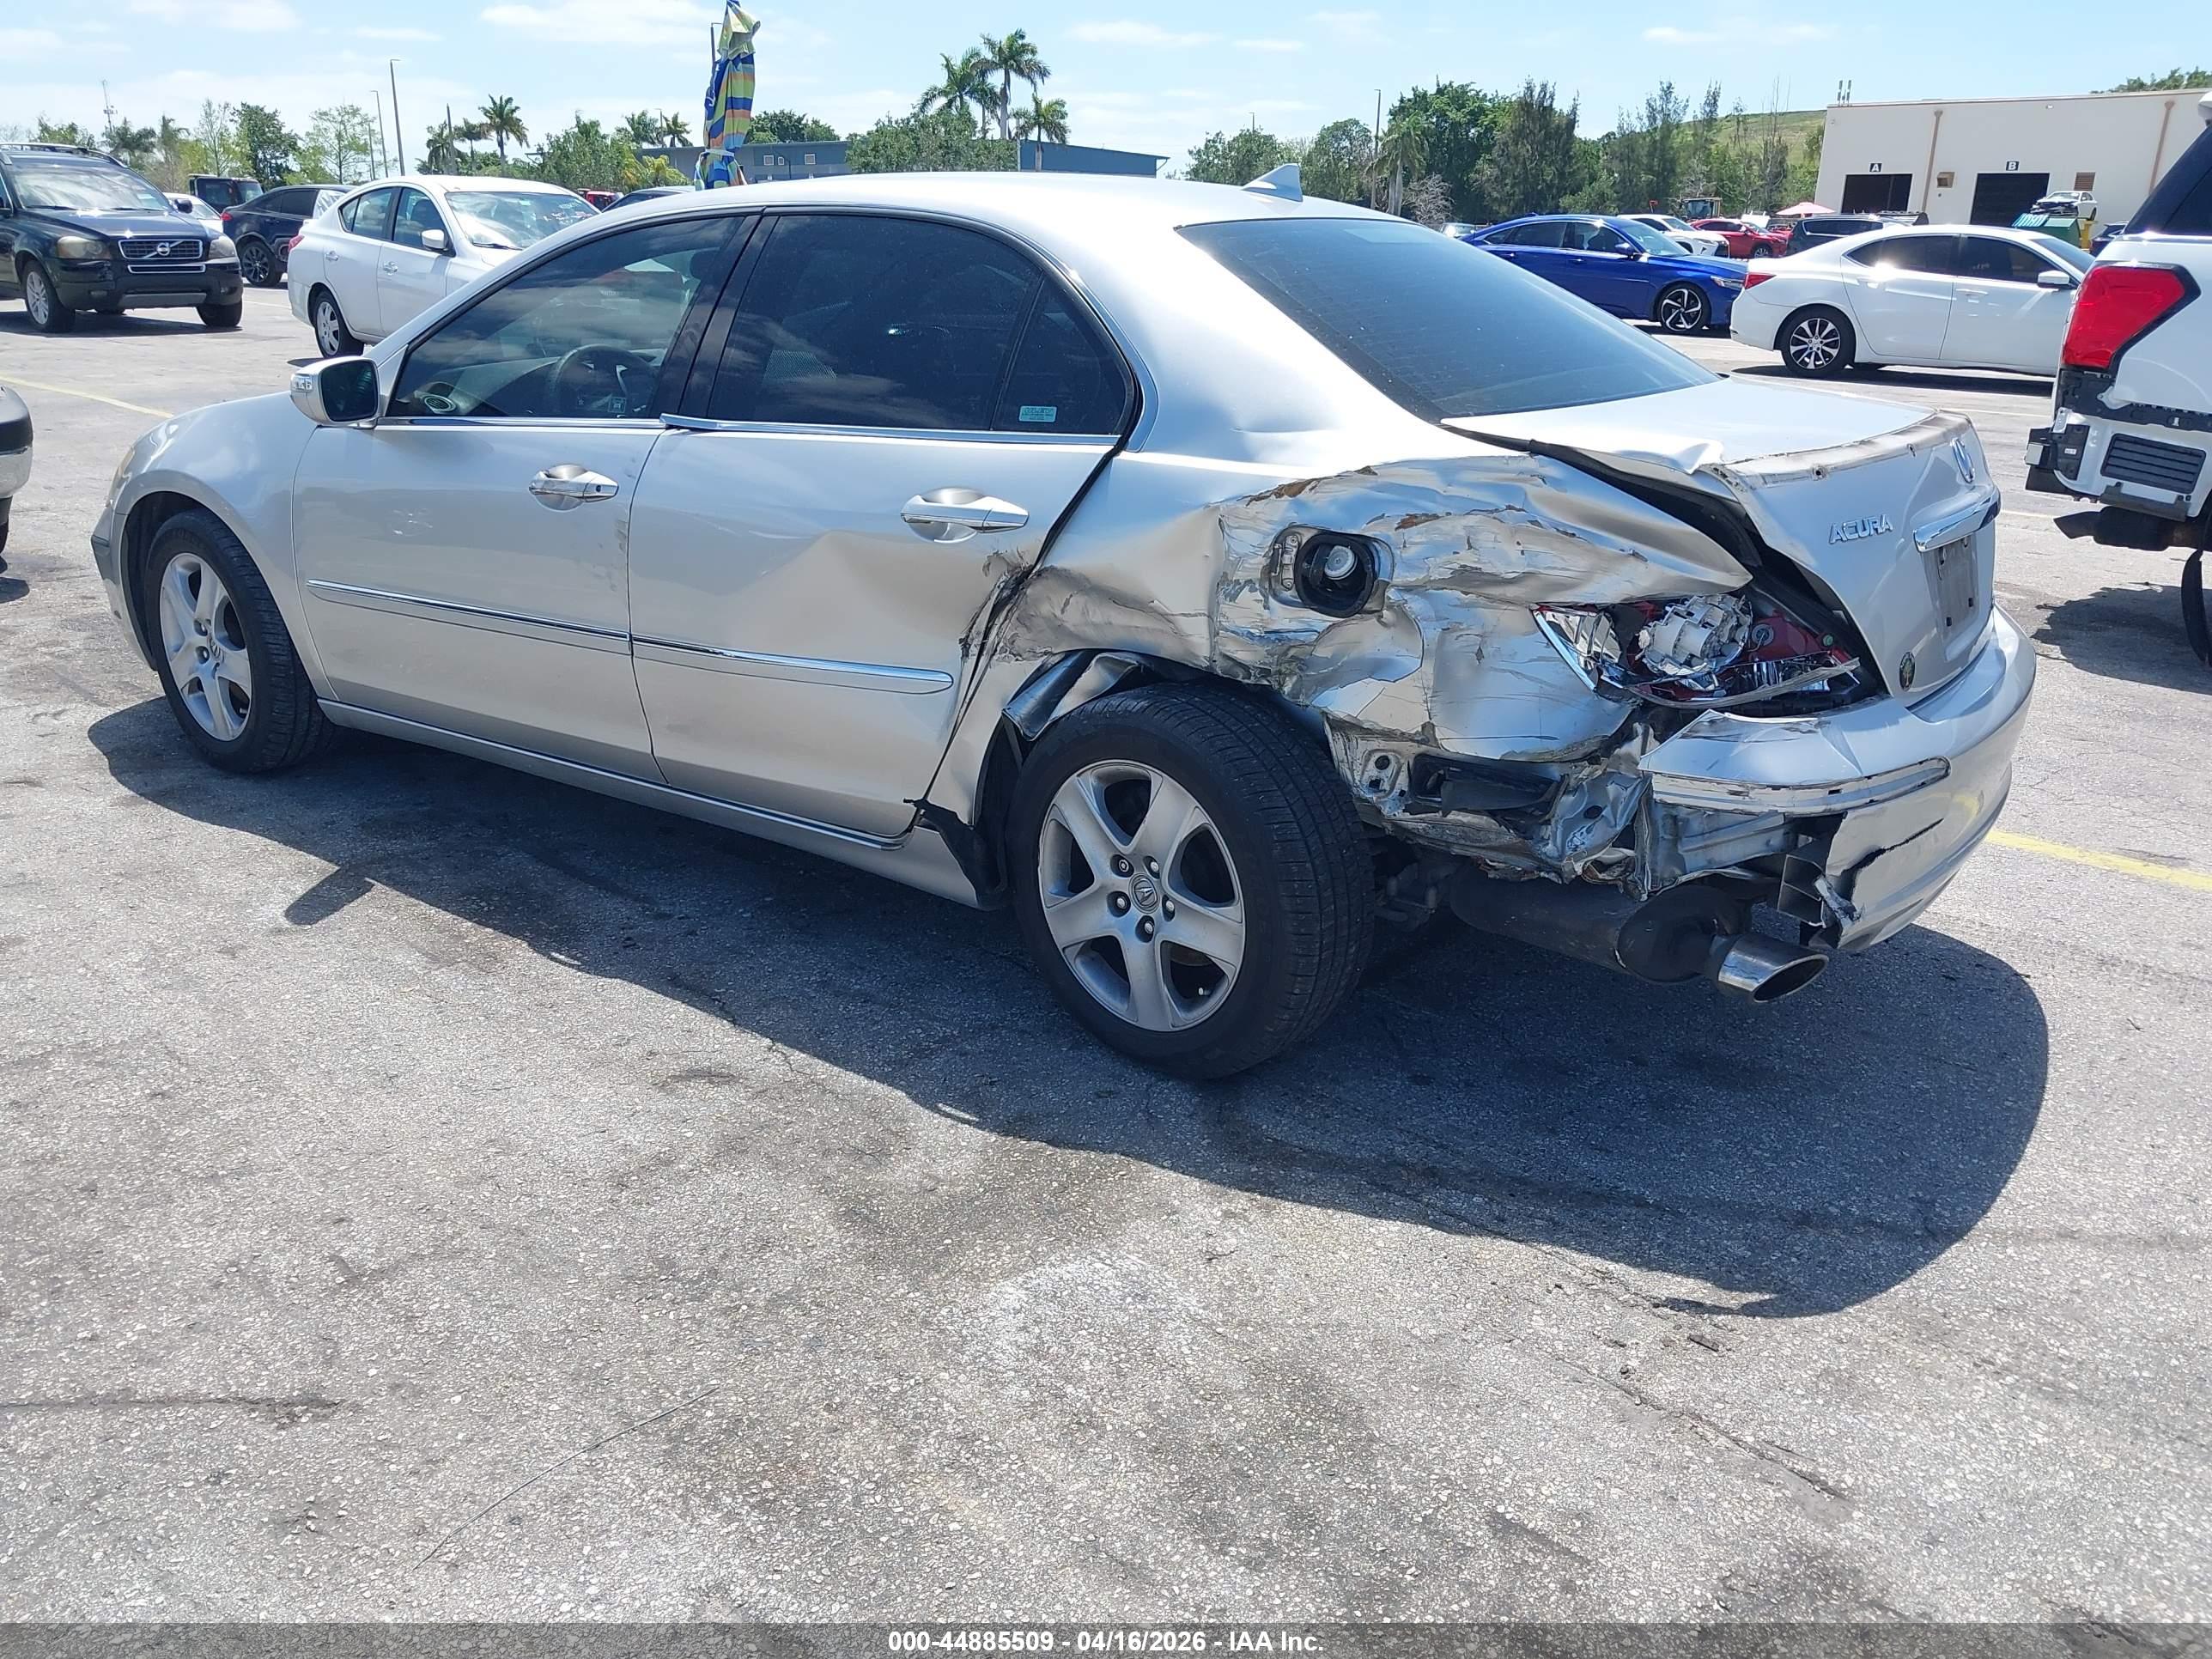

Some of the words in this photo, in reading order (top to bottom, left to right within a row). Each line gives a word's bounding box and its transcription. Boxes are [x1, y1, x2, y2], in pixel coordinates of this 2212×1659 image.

[1871, 163, 1881, 172] A
[2008, 161, 2016, 171] B
[1829, 514, 1893, 544] ACURA
